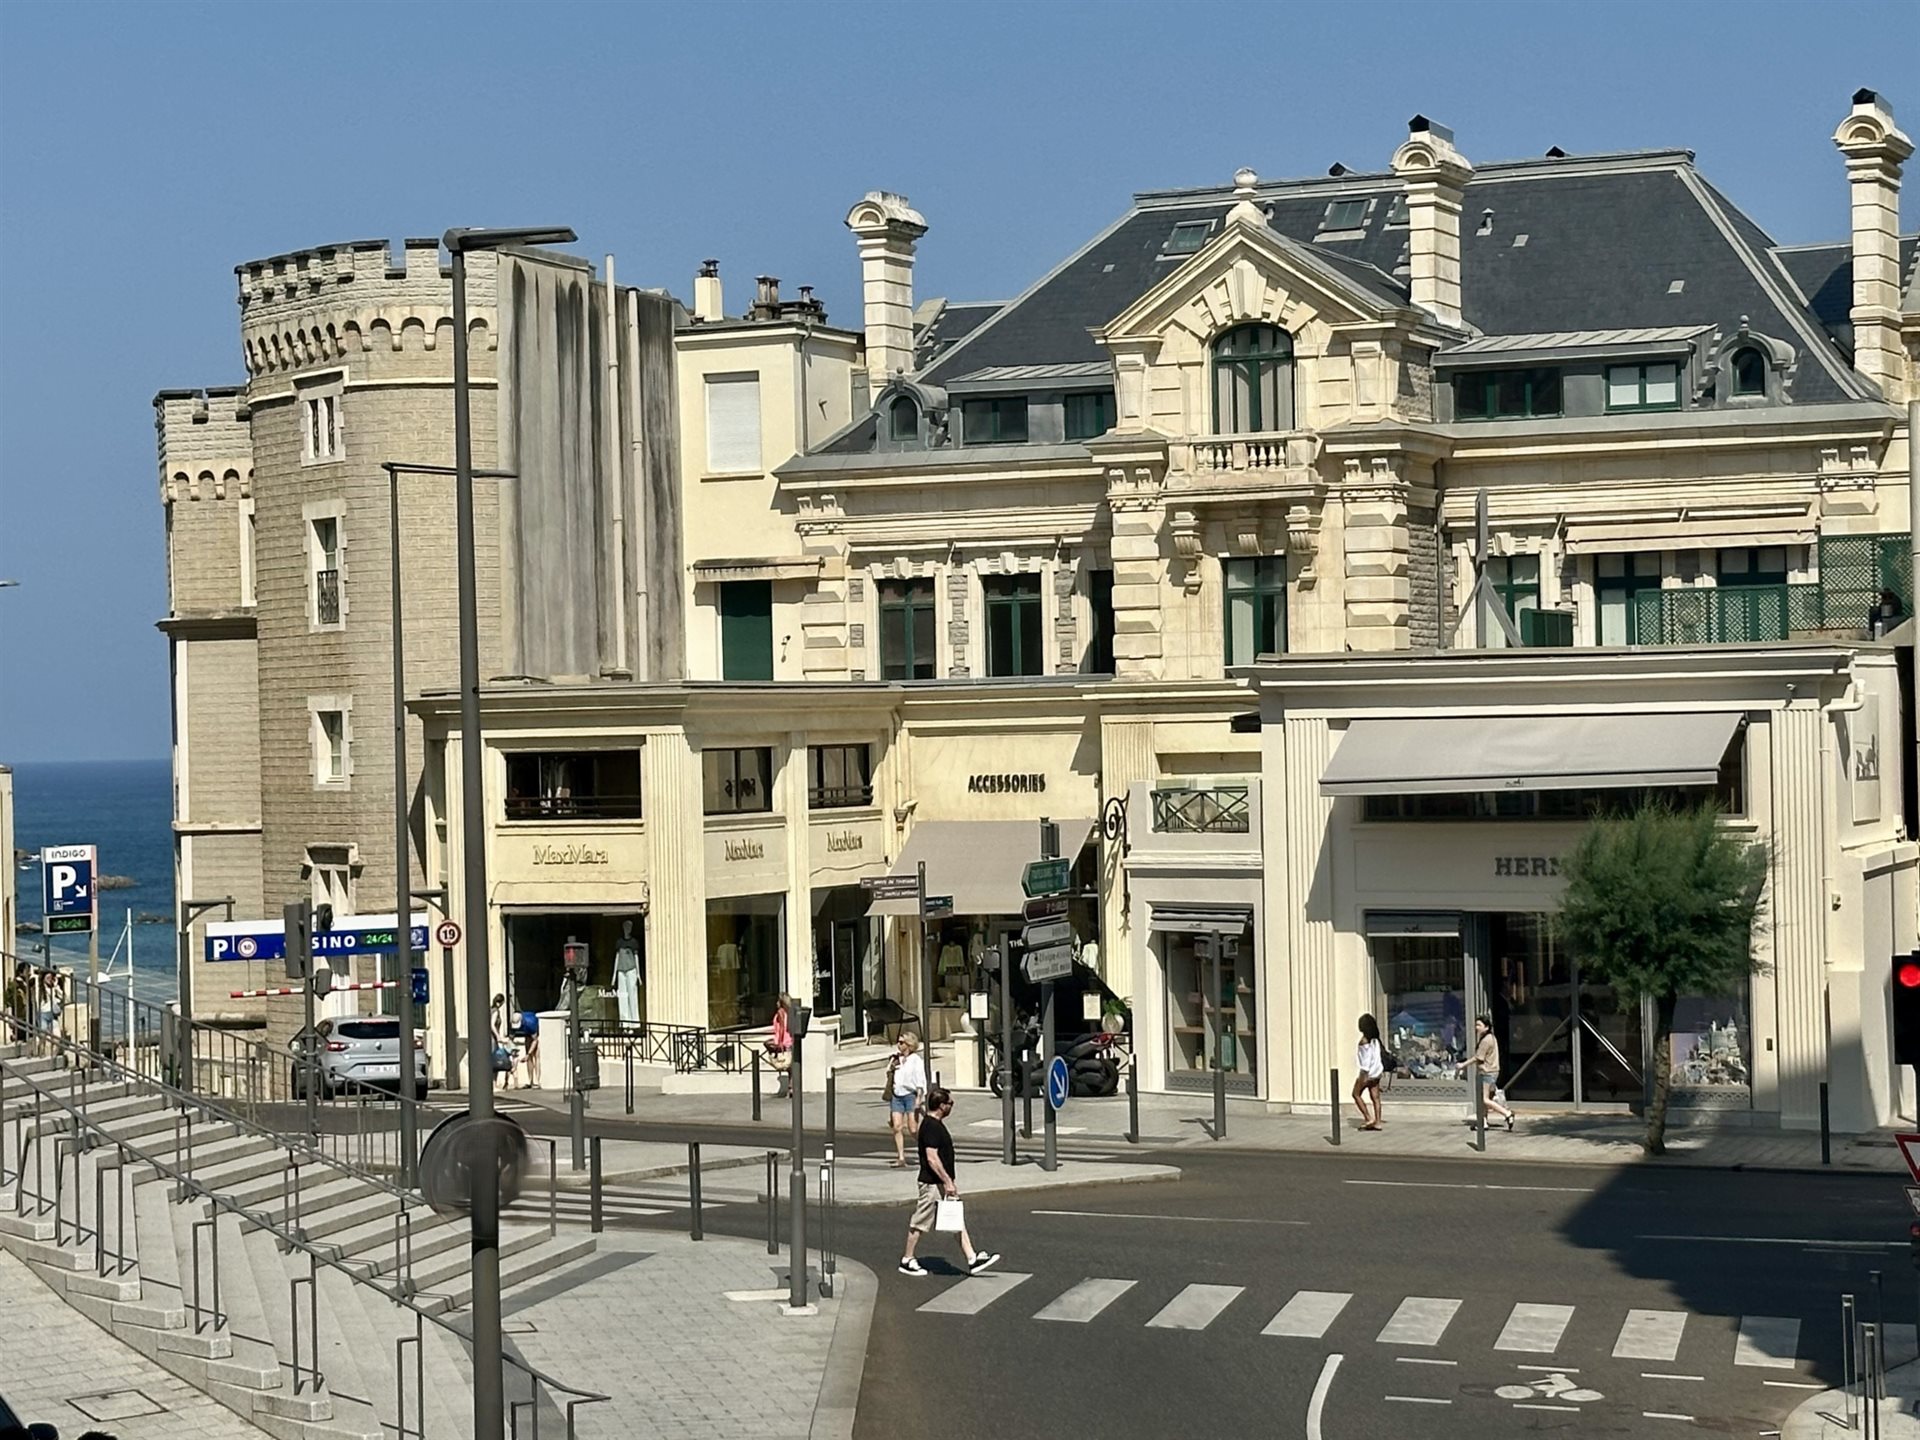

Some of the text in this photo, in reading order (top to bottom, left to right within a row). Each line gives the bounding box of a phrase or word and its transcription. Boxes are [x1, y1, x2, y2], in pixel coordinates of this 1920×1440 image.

[968, 773, 1046, 793] ACCESSORIES
[51, 850, 85, 858] INDIGO
[532, 844, 609, 865] MaxMara
[52, 865, 77, 899] P
[213, 939, 229, 960] P
[312, 936, 356, 949] SINO
[366, 934, 393, 944] 24/24
